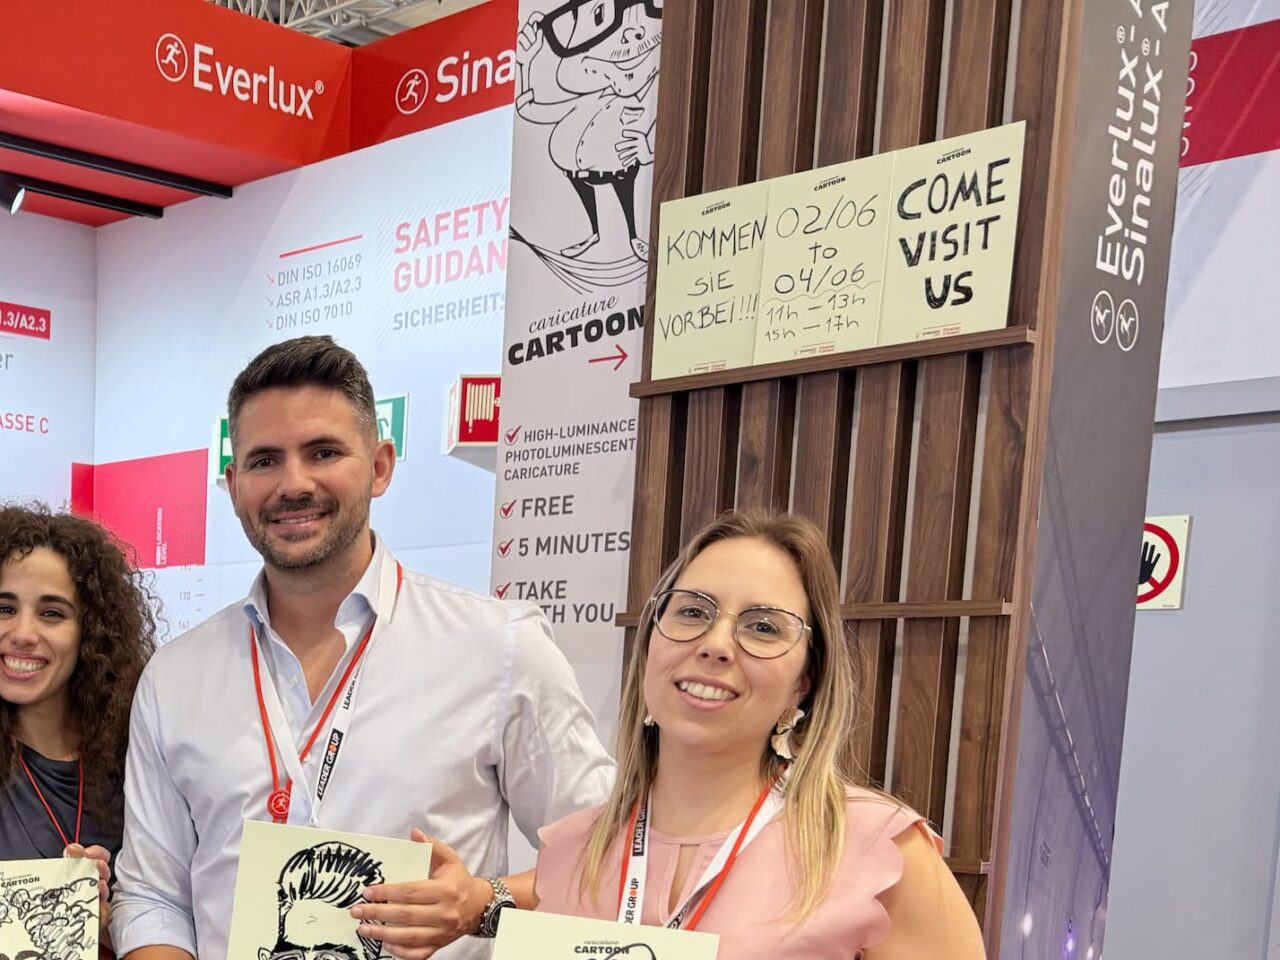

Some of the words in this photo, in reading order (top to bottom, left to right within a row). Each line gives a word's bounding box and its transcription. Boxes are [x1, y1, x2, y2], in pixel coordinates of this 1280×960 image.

[435, 49, 516, 104] Sina
[937, 149, 971, 164] CARTOON
[814, 176, 846, 191] CARTOON
[897, 157, 1011, 220] COME
[701, 202, 731, 215] CARTOON
[776, 194, 878, 238] 02/06
[395, 197, 510, 254] SAFETY
[667, 211, 768, 266] KOMMEN
[898, 215, 1001, 267] VISIT
[278, 266, 299, 286] DIN
[302, 263, 322, 279] ISO
[327, 254, 362, 275] 16069
[774, 262, 865, 293] 04/06
[276, 290, 300, 309] ASR
[304, 276, 362, 301] A1.3/A2.3
[827, 293, 865, 311] 13h
[925, 271, 973, 310] US
[276, 314, 297, 331] DIN
[301, 310, 321, 326] ISO
[324, 301, 353, 321] 7010
[393, 291, 505, 331] SICHERHEIT
[529, 295, 619, 334] caricature
[508, 304, 645, 366] CARTOON
[39, 417, 49, 434] C
[523, 418, 636, 443] HIGH-LUMINANCE
[505, 437, 636, 464] PHOTOLUMINESCENT
[503, 462, 580, 481] CARICATURE
[521, 495, 574, 518] FREE
[518, 538, 528, 557] 5
[535, 531, 631, 555] MINUTES
[515, 579, 567, 601] TAKE
[572, 602, 614, 623] YOU
[574, 946, 629, 954] CARTOON
